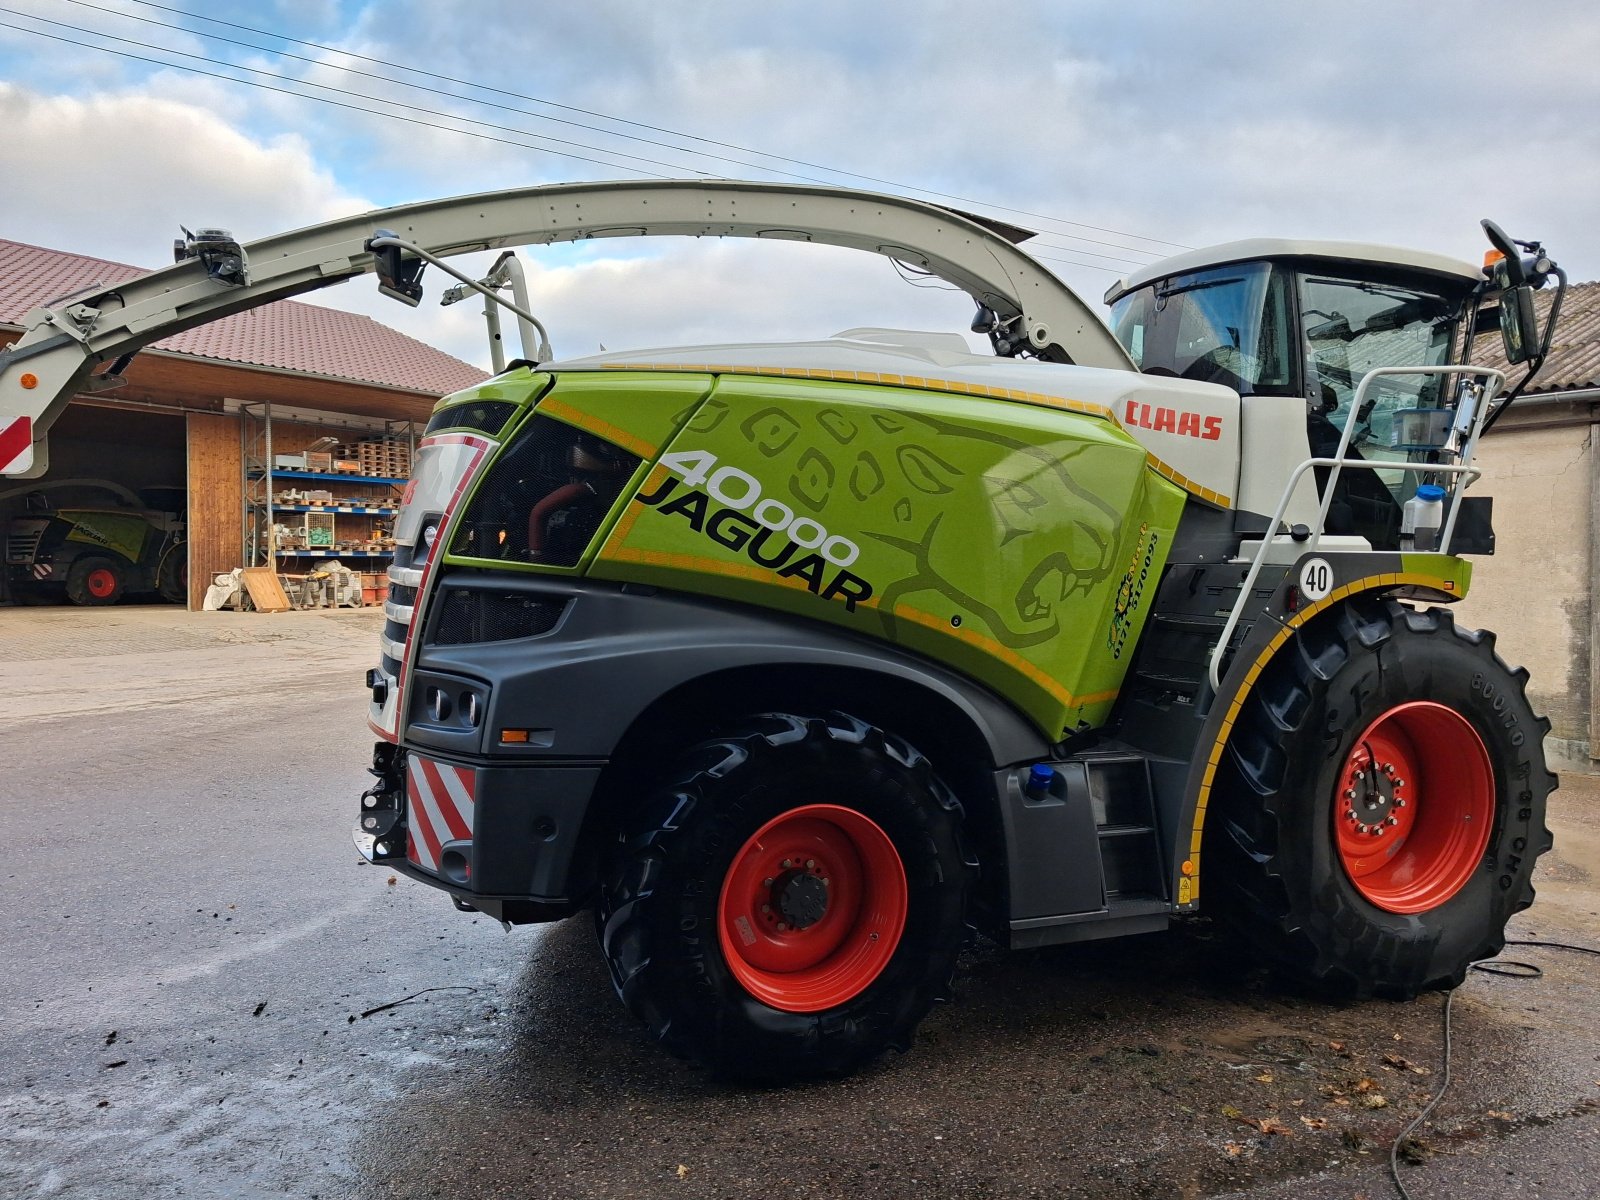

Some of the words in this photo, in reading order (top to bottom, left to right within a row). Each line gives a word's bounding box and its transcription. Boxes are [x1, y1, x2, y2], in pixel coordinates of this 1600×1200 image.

[1125, 400, 1222, 440] CLAAS
[634, 476, 873, 613] JAGUAR
[1306, 565, 1327, 592] 40
[1113, 619, 1132, 661] 0171
